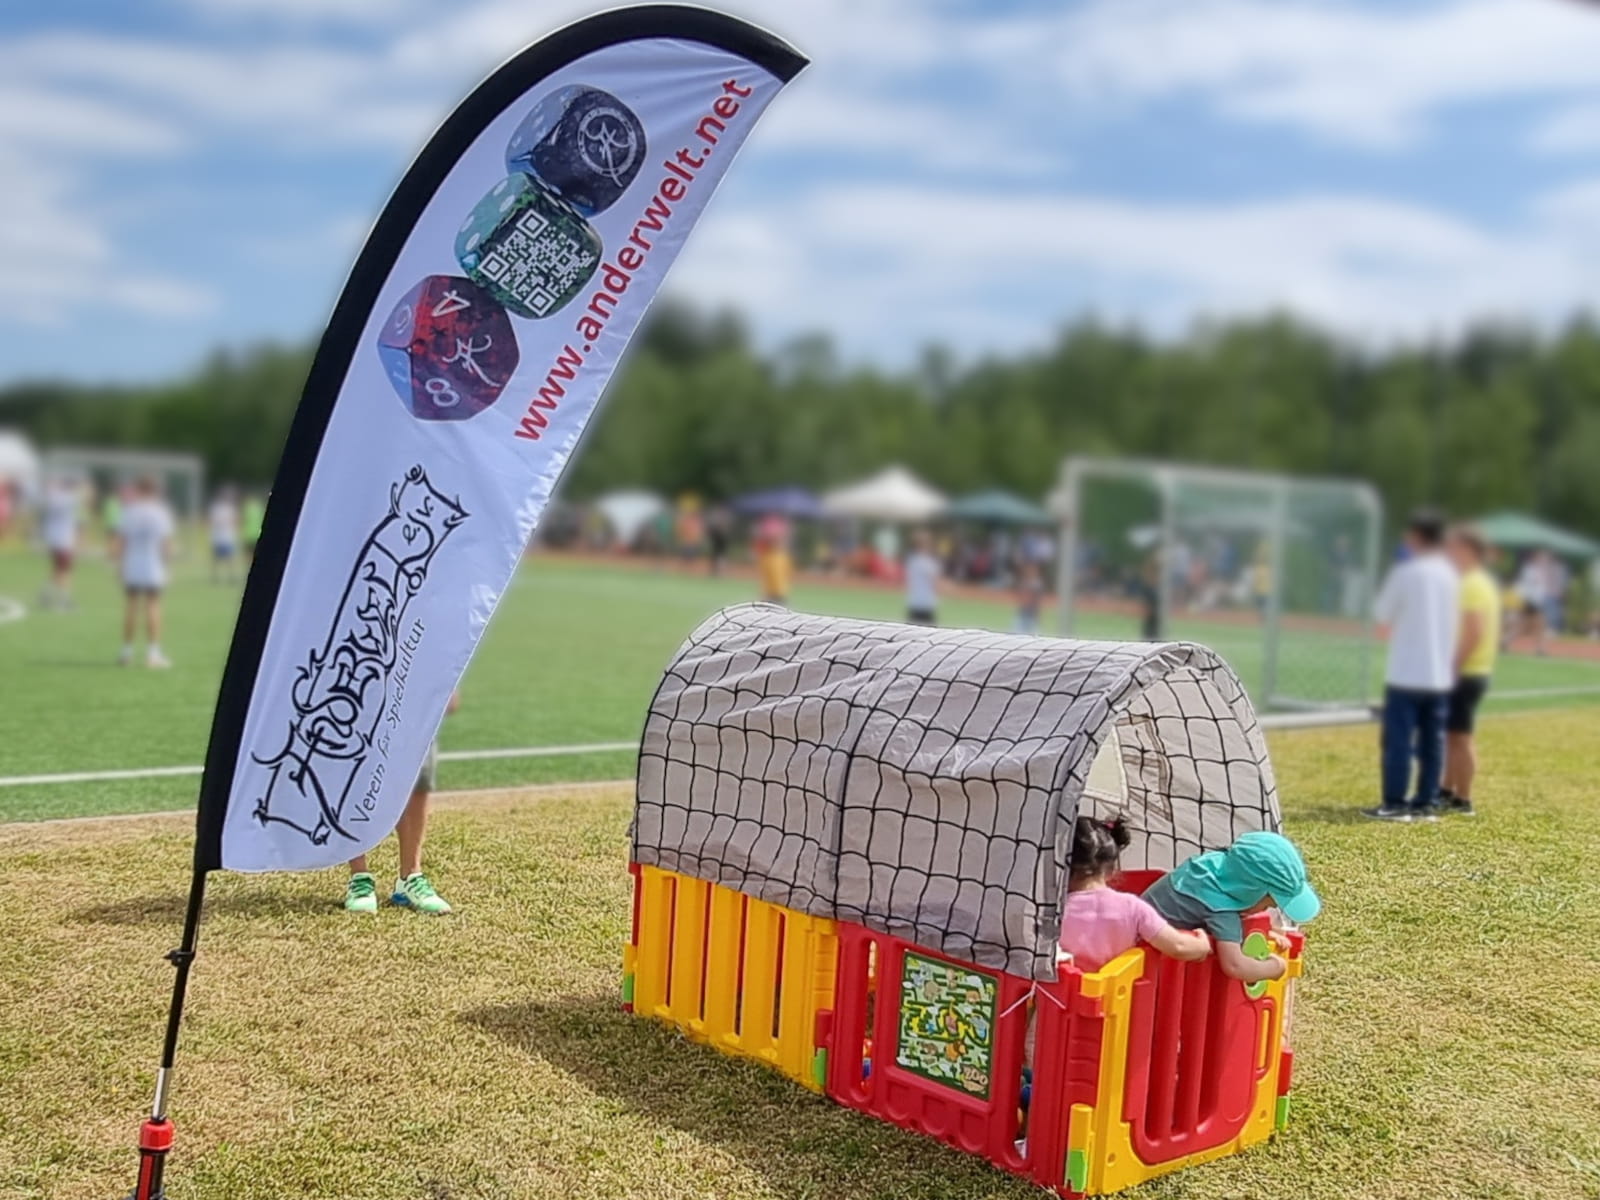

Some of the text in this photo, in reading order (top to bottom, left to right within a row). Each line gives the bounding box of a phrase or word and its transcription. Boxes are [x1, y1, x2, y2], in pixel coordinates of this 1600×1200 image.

[514, 78, 753, 441] www.anderwelt.net
[350, 762, 386, 822] Verein
[385, 617, 426, 730] Spielkultur
